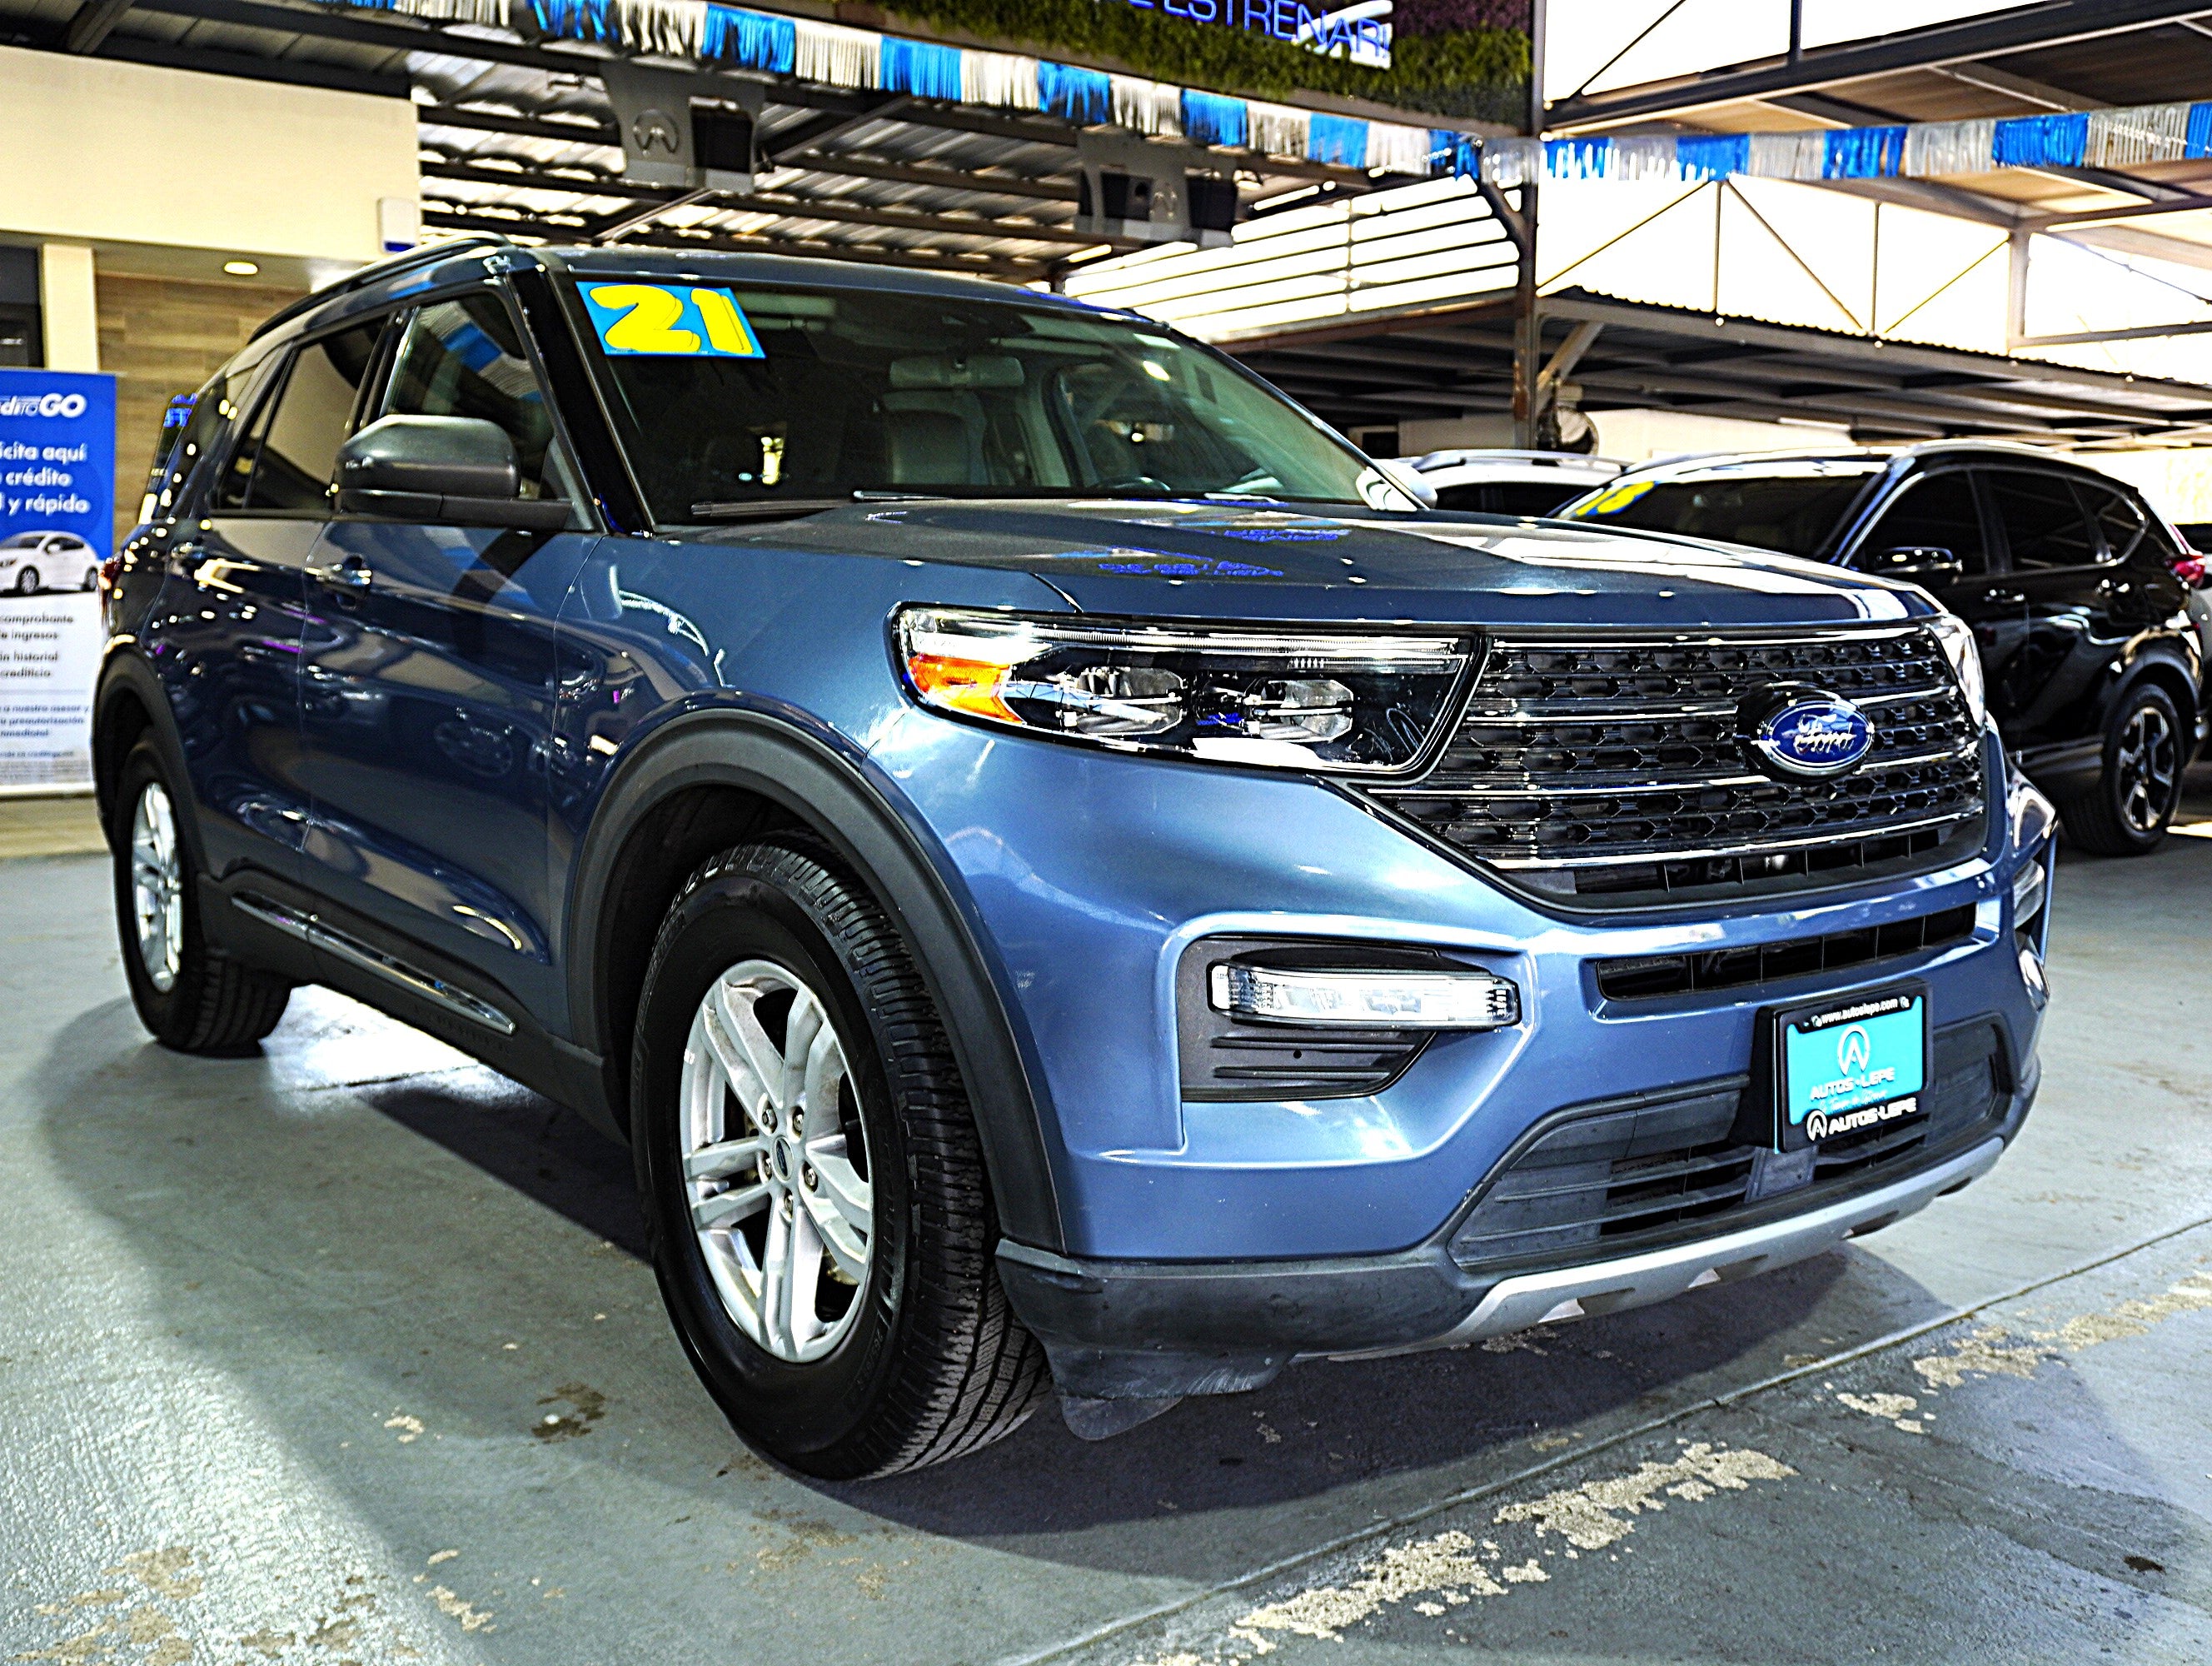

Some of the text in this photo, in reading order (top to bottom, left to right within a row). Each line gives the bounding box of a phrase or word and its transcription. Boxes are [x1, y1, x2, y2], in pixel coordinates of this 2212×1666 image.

[590, 284, 754, 354] 21
[42, 442, 87, 465] aquí
[6, 466, 73, 487] crédito
[8, 497, 22, 516] y
[26, 493, 91, 516] rápido
[12, 630, 59, 642] ingresos
[14, 650, 58, 662] historial
[1793, 713, 1857, 755] Ford
